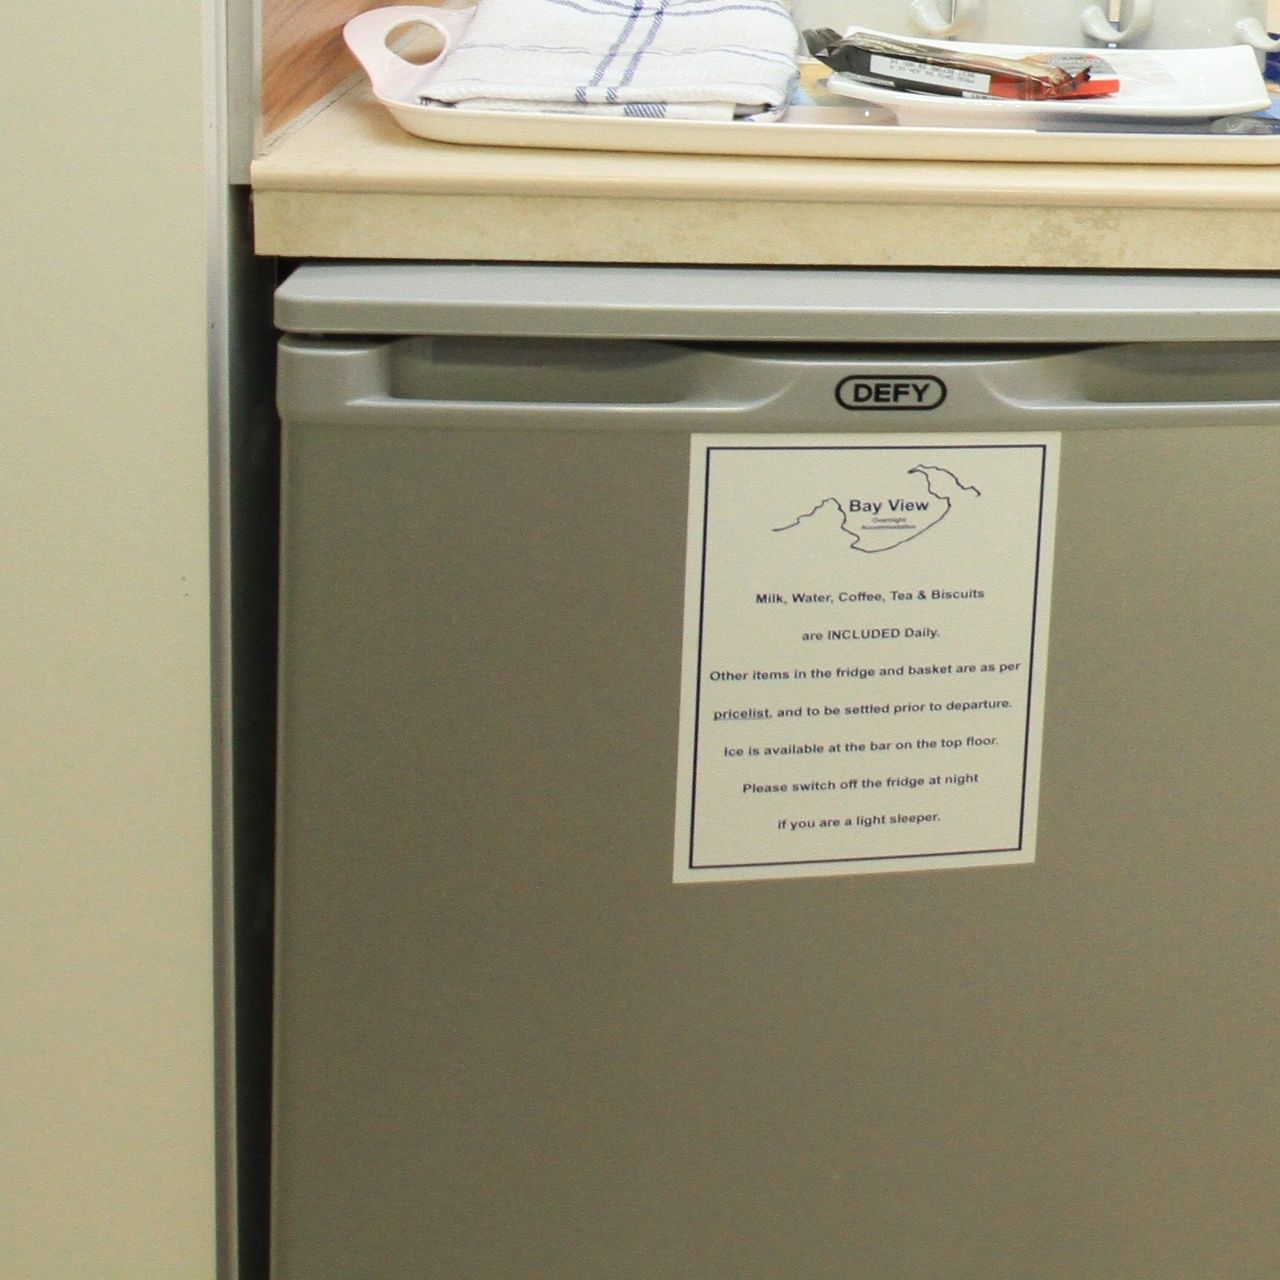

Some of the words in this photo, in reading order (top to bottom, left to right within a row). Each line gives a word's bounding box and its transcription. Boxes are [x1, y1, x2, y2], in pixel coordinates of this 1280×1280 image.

[853, 383, 930, 403] DEFY
[849, 498, 883, 516] Bay
[888, 498, 930, 512] View
[756, 593, 788, 606] Milk,
[792, 592, 834, 604] Water,
[838, 591, 886, 603] Coffee,
[890, 590, 914, 602] Tea
[917, 589, 928, 601] &
[931, 588, 985, 600] Biscuits
[802, 632, 824, 642] are
[828, 627, 901, 641] INCLUDED
[904, 627, 941, 640] Daily.
[710, 670, 749, 682] Other
[753, 669, 790, 681] items
[794, 668, 807, 680] in
[810, 668, 833, 679] the
[836, 666, 876, 680] fridge
[879, 665, 905, 677] and
[908, 663, 953, 676] basket
[956, 664, 977, 674] are
[980, 663, 996, 673] as
[999, 662, 1022, 674] per
[713, 707, 773, 722] pricelist,
[777, 706, 803, 718] and
[807, 706, 821, 717] to
[824, 705, 841, 716] be
[845, 703, 890, 716] settled
[894, 702, 926, 716] prior
[929, 701, 943, 712] to
[946, 699, 1013, 713] departure.
[724, 746, 745, 758] Ice
[749, 745, 761, 757] is
[764, 743, 825, 756] available
[828, 743, 842, 754] at
[845, 741, 866, 753] the
[870, 740, 892, 752] bar
[895, 741, 913, 751] on
[917, 738, 938, 750] the
[941, 738, 963, 750] top
[966, 735, 999, 747] floor.
[743, 783, 788, 795] Please
[792, 779, 837, 792] switch
[840, 778, 859, 790] off
[861, 777, 883, 789] the
[886, 776, 926, 789] fridge
[929, 775, 942, 786] at
[945, 772, 979, 787] night
[778, 818, 787, 830] if
[790, 820, 816, 832] you
[819, 818, 841, 828] are
[844, 817, 853, 827] a
[856, 814, 886, 828] light
[890, 813, 941, 825] sleeper.
